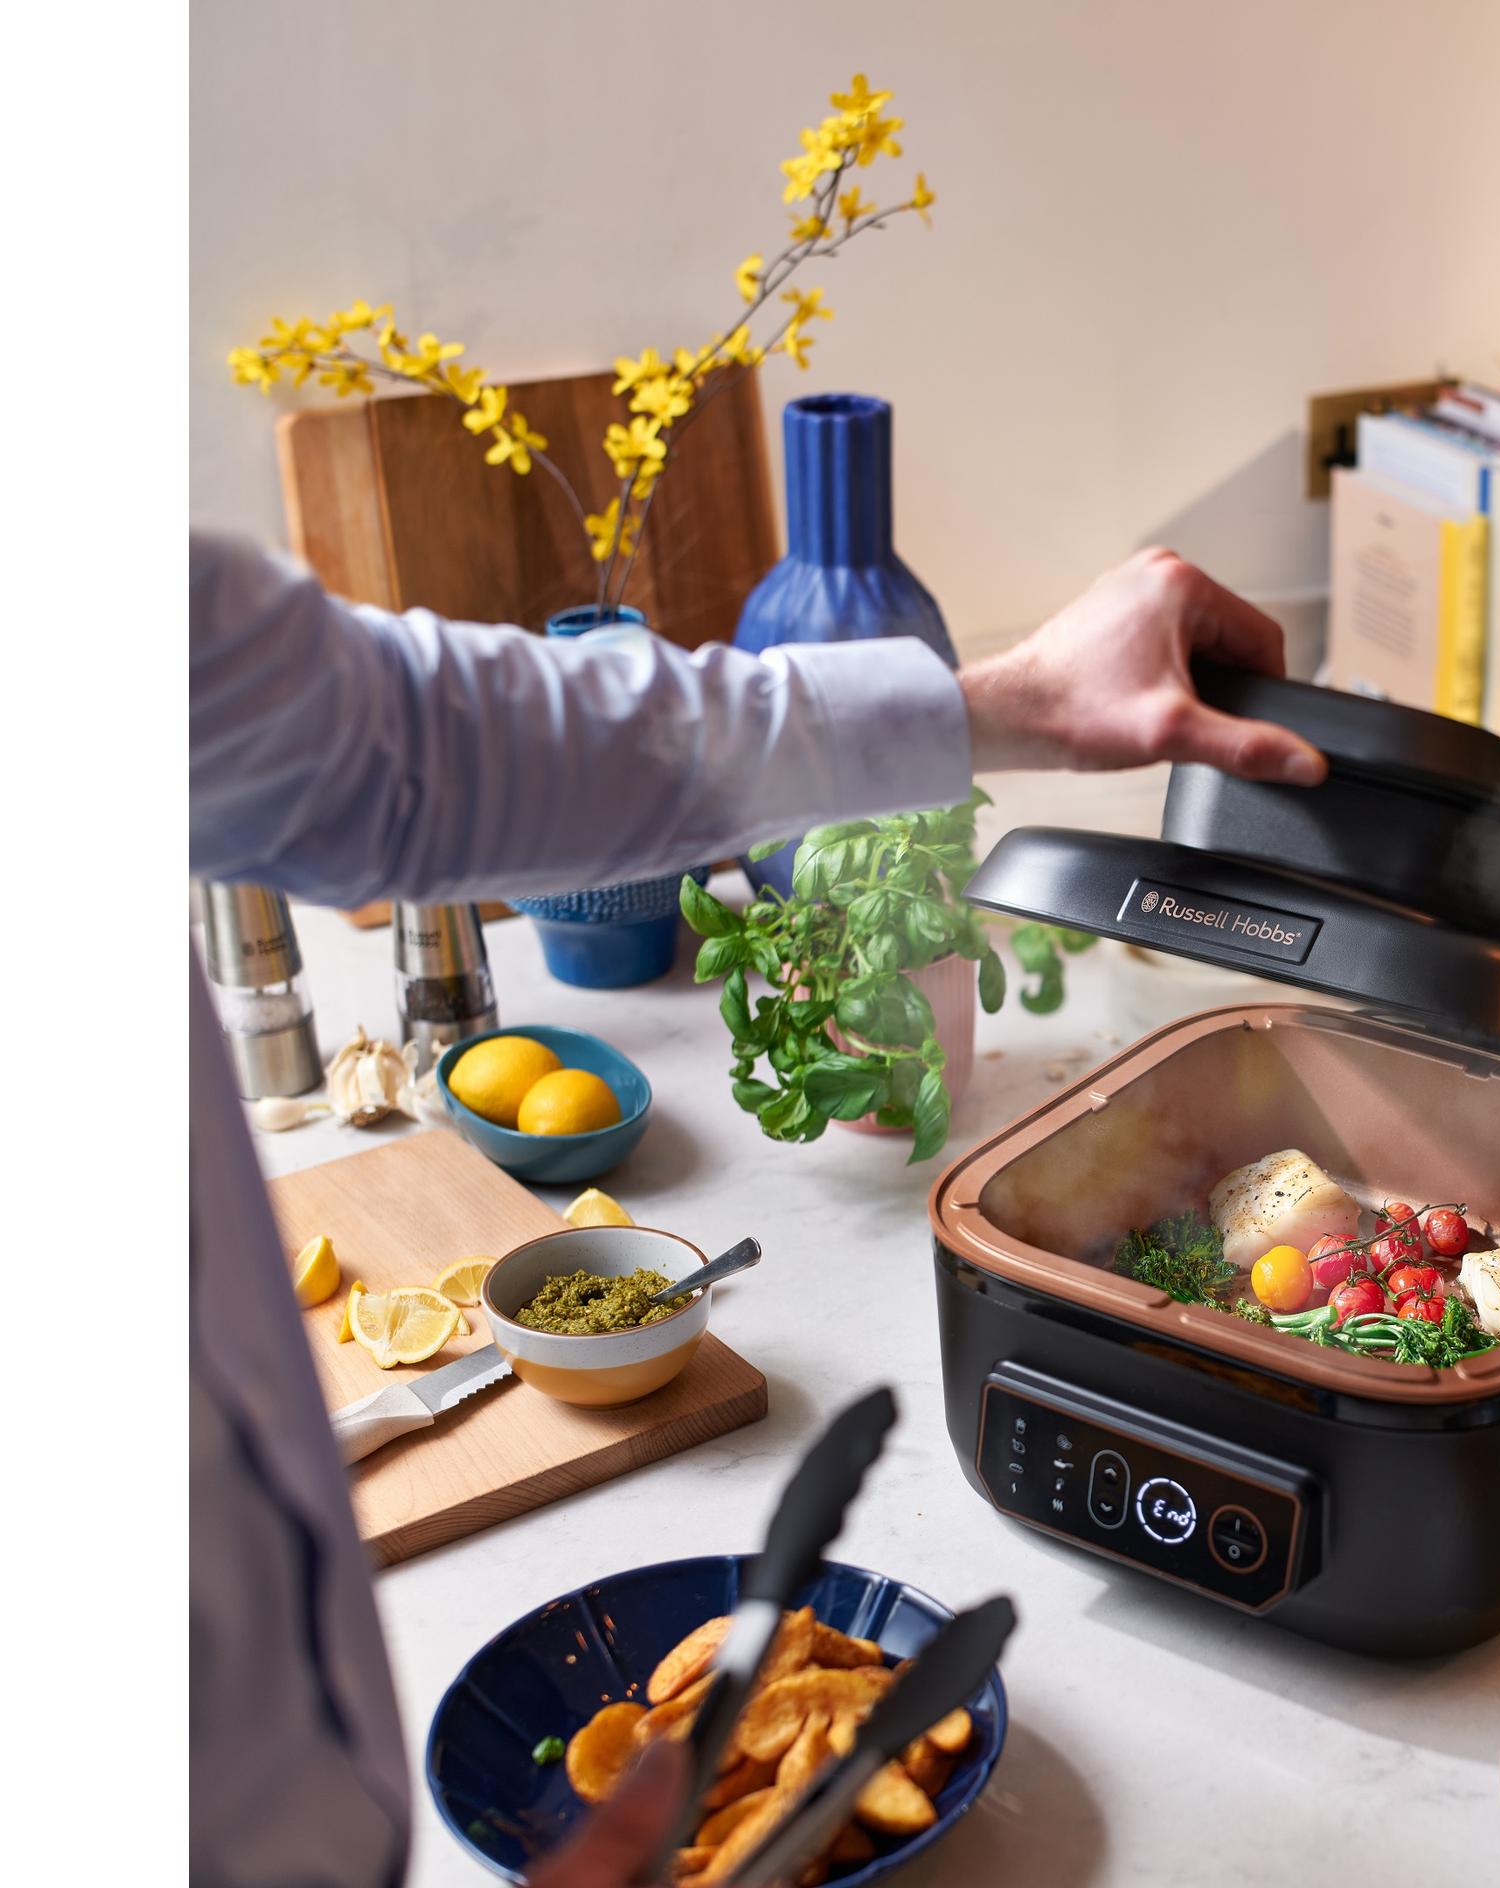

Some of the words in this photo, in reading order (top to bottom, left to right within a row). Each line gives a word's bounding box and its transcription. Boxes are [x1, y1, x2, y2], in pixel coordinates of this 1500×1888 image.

[1159, 896, 1229, 929] Russell
[1231, 914, 1296, 946] Hobbs
[1153, 1499, 1191, 1526] End
